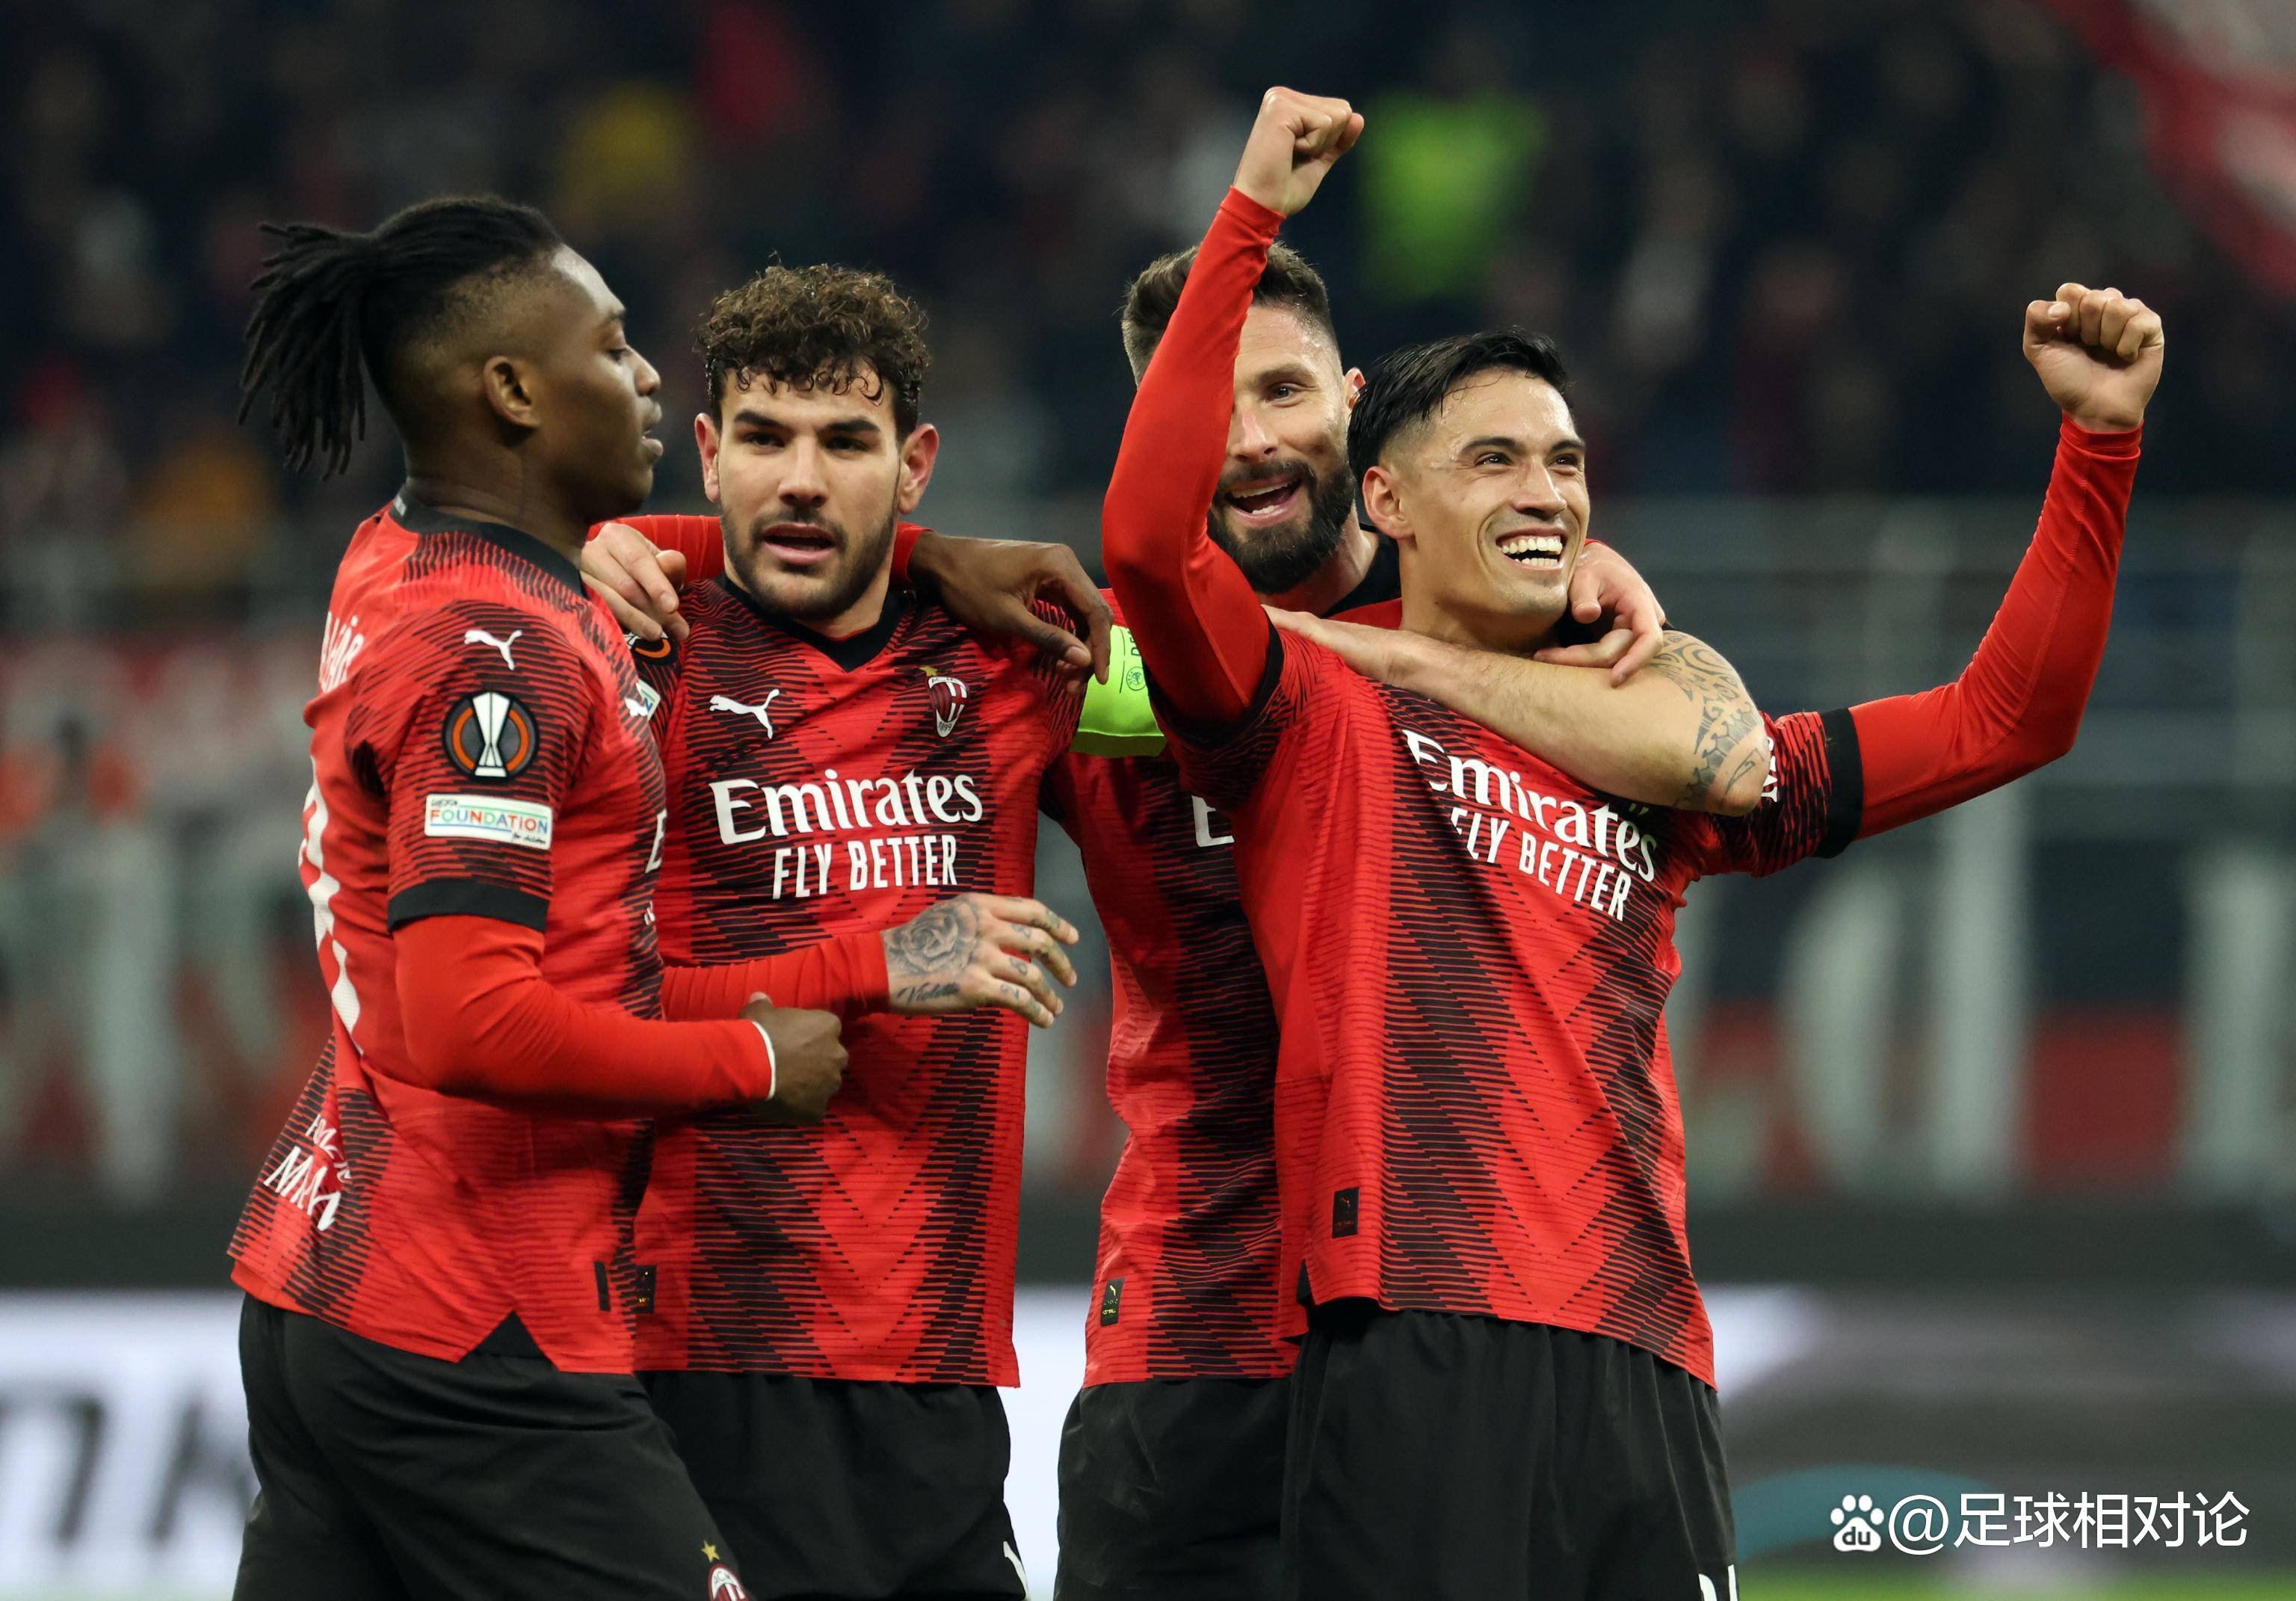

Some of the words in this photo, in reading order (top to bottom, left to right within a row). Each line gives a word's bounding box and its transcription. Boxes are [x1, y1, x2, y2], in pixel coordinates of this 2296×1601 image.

[939, 721, 952, 732] 1899
[430, 809, 548, 834] FOUNDATION
[709, 768, 983, 845] Emirates
[772, 844, 832, 900] FLY
[849, 834, 957, 891] BETTER
[1519, 831, 1632, 922] BETTER
